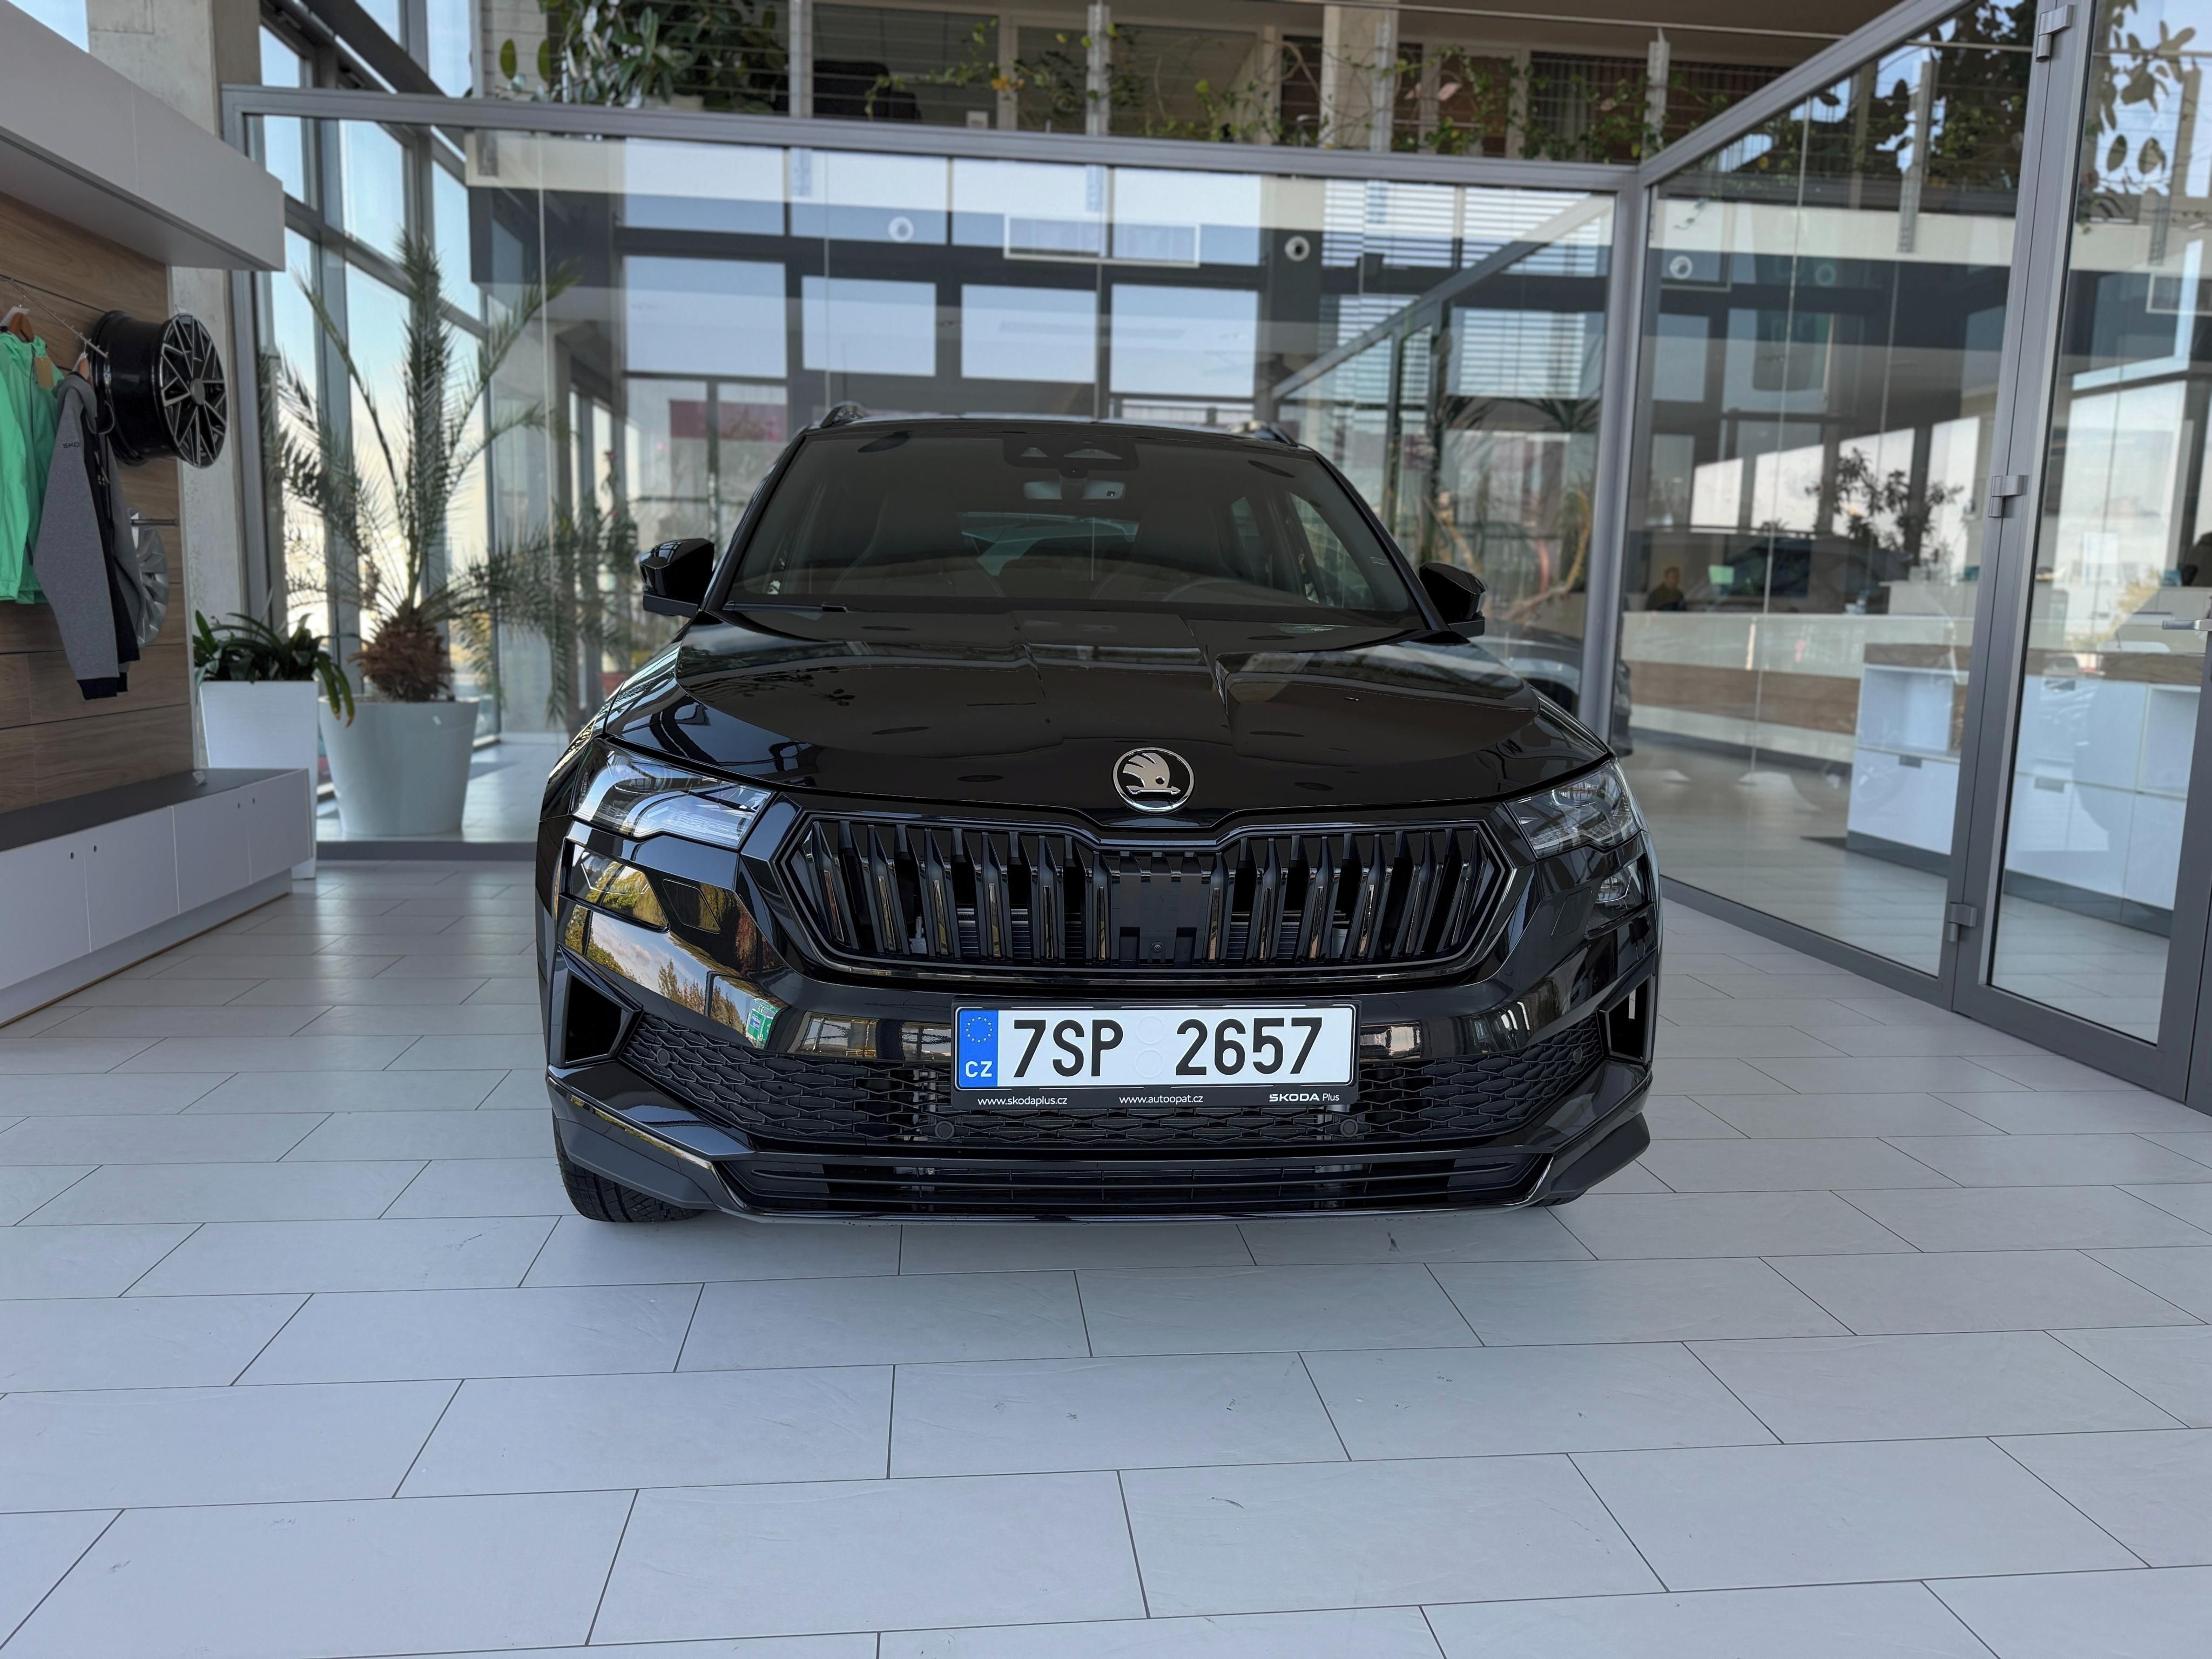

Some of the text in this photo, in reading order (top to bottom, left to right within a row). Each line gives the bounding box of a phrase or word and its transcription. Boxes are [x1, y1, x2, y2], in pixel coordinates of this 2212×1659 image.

[1013, 1017, 1323, 1078] 7SP 2657
[965, 1061, 993, 1078] CZ
[977, 1096, 1068, 1107] www.skodaplus.cz
[1119, 1095, 1204, 1105] www.autoopat.cz
[1322, 1093, 1340, 1101] Plus
